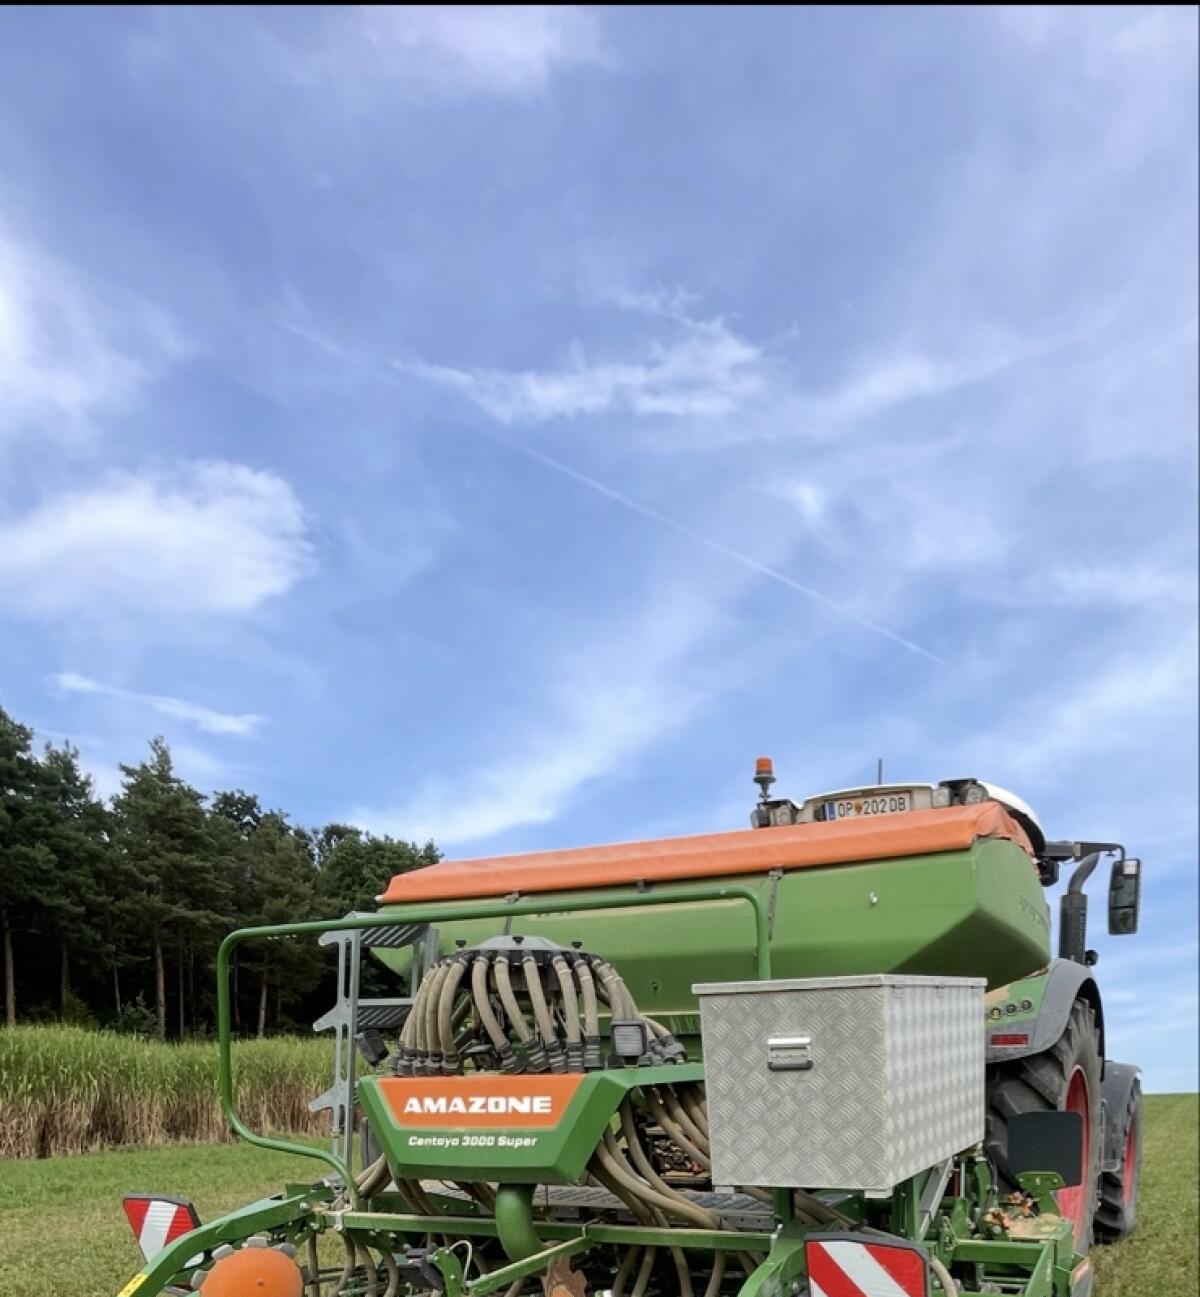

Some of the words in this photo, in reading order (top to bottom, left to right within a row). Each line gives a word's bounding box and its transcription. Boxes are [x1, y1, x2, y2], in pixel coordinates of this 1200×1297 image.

[838, 802, 853, 817] OP
[404, 1096, 552, 1113] AMAZONE
[462, 1135, 495, 1146] 3000
[497, 1136, 538, 1148] Super
